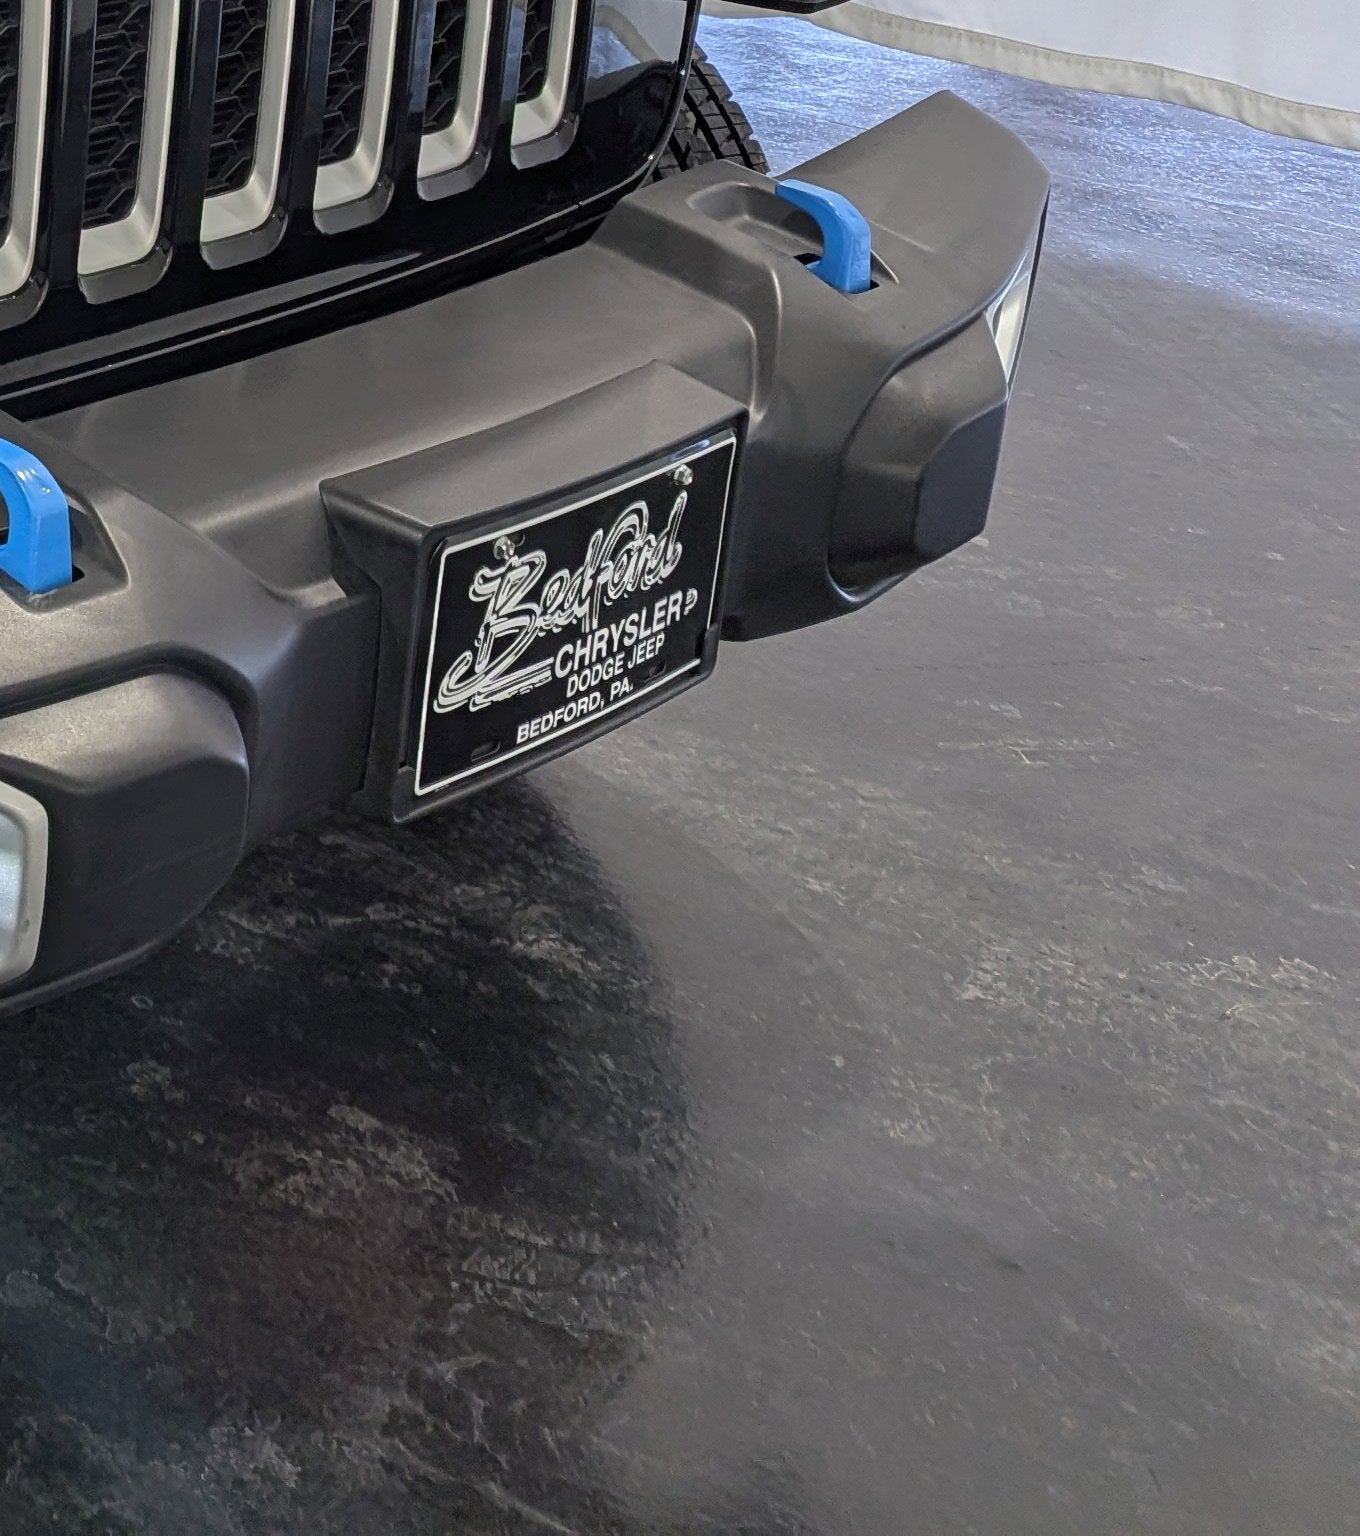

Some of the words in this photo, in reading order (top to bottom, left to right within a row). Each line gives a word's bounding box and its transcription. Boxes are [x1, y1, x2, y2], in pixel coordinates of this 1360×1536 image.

[433, 490, 688, 713] Bedford
[554, 590, 683, 679] CHRYSLER
[566, 651, 625, 698] DODGE
[627, 631, 665, 669] JEEP
[516, 690, 606, 745] BEDFORD,
[610, 676, 634, 702] PA.
